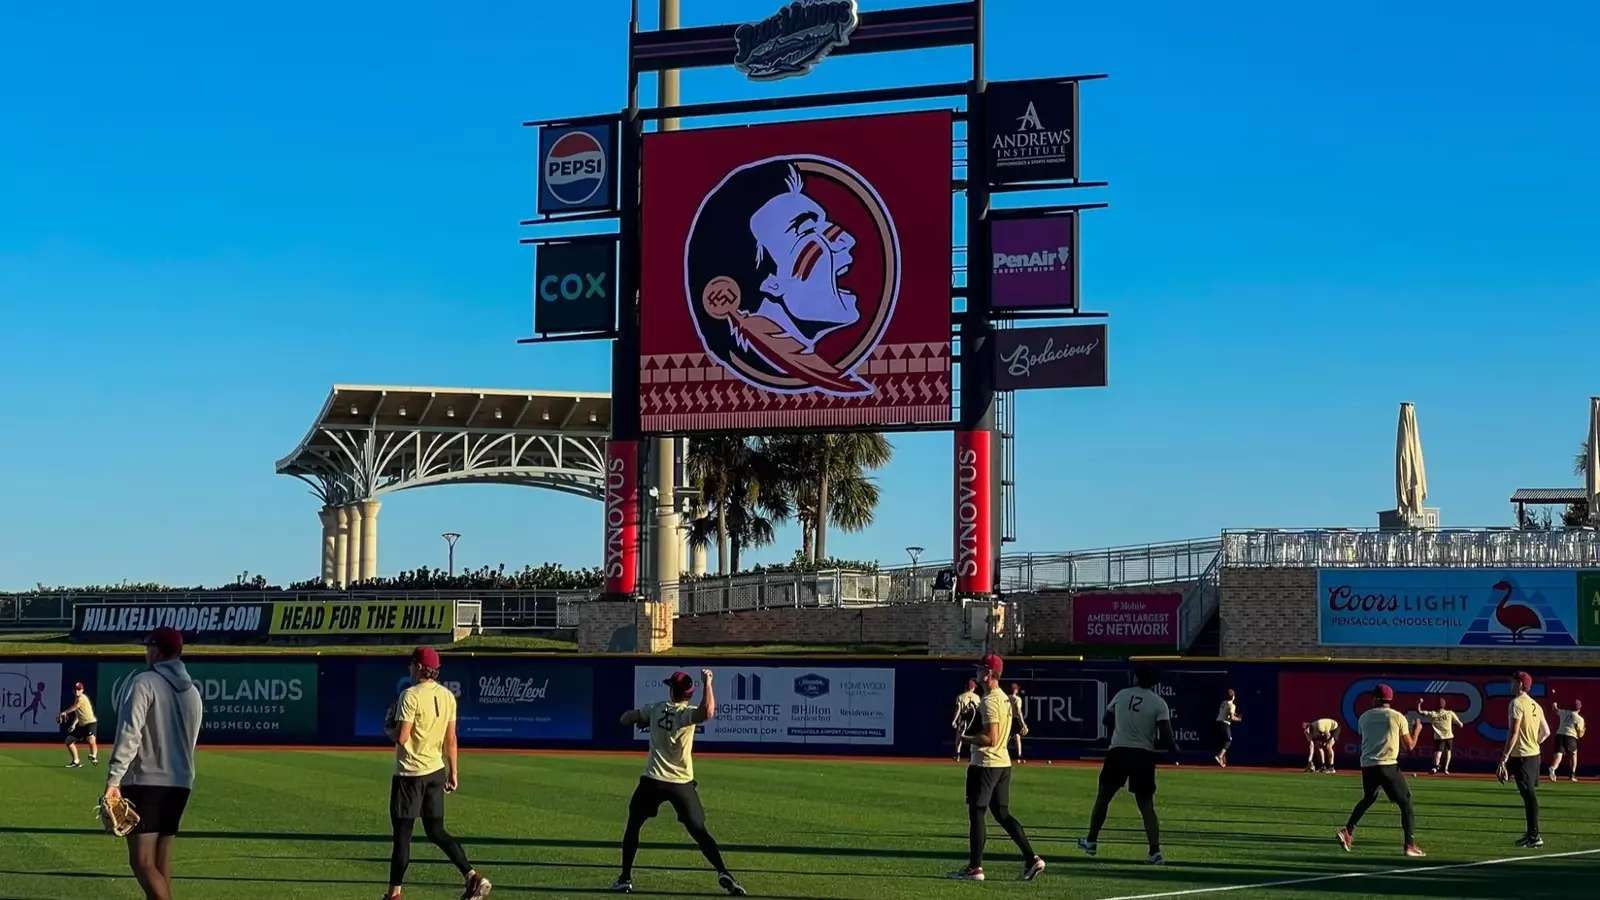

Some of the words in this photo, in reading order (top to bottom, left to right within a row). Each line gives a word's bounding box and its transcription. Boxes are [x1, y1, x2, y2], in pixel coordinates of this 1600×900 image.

[992, 128, 1071, 149] ANDREWS
[997, 145, 1065, 158] INSTITUTE
[549, 158, 602, 177] PEPSI
[992, 250, 1057, 269] PenAir
[993, 267, 1023, 275] CREDIT
[1028, 265, 1055, 273] UNION
[540, 271, 606, 302] COX
[1000, 337, 1099, 377] Bodacious
[606, 457, 624, 578] SYNOVUS
[956, 449, 978, 577] SYNOVUS
[1328, 585, 1399, 611] Coors
[1404, 594, 1469, 612] LIGHT
[82, 606, 262, 631] HILLKELLYDODGE.COM
[280, 605, 326, 630] HEAD
[328, 605, 362, 630] FOR
[365, 605, 398, 629] THE
[400, 604, 446, 630] HILL!
[1087, 613, 1131, 622] AMERICA'S
[1133, 613, 1170, 622] LARGEST
[1392, 616, 1432, 626] CHOOSE
[1435, 616, 1463, 627] CHILL
[1087, 623, 1105, 635] 5G
[1106, 623, 1170, 636] NETWORK
[479, 696, 515, 704] INSURANCE
[715, 703, 780, 715] HIGHPOINTE
[1024, 690, 1084, 722] TRL
[1128, 695, 1144, 713] 12
[213, 705, 285, 714] SPECIALISTS
[800, 704, 831, 715] Hilton
[1531, 703, 1537, 717] 2
[715, 727, 777, 735] HIGHPOINTE.COM
